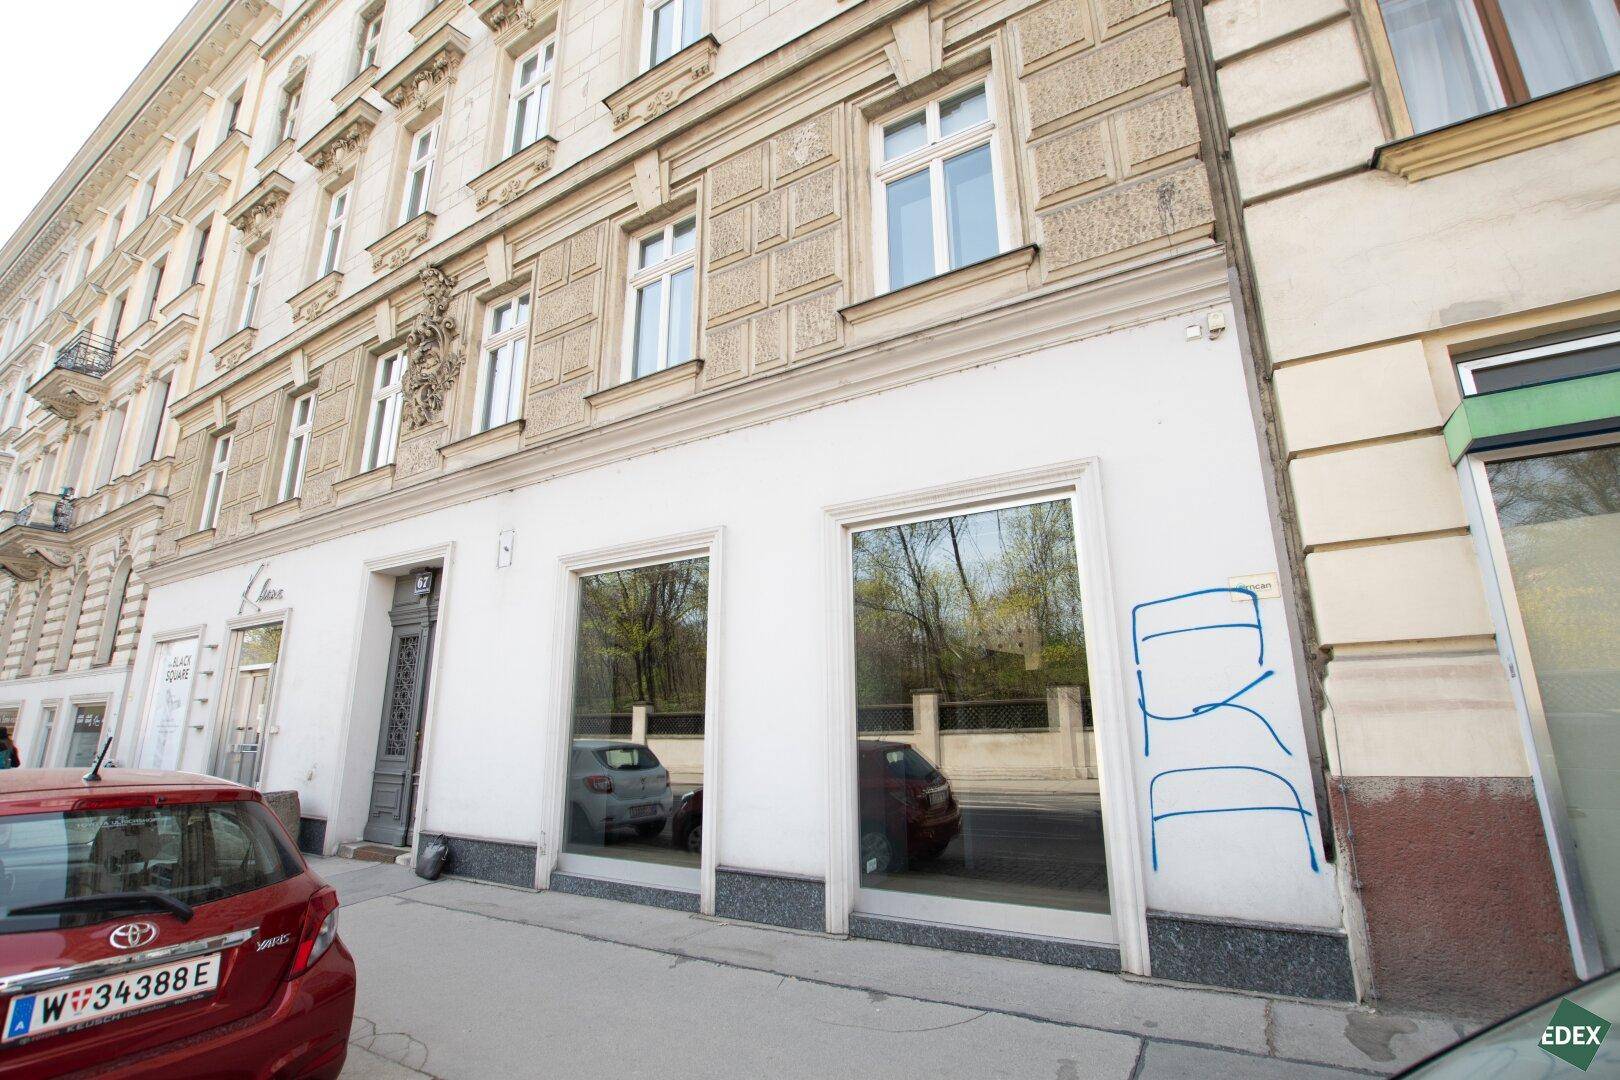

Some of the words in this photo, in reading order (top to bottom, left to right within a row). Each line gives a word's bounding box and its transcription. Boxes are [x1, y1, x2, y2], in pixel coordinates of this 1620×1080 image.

[417, 576, 430, 589] 67
[173, 655, 192, 668] BLACK
[165, 668, 190, 684] SQUARE
[256, 933, 291, 952] YARIS
[14, 1020, 25, 1032] A
[43, 992, 69, 1024] W
[67, 1014, 121, 1033] KEUSCH
